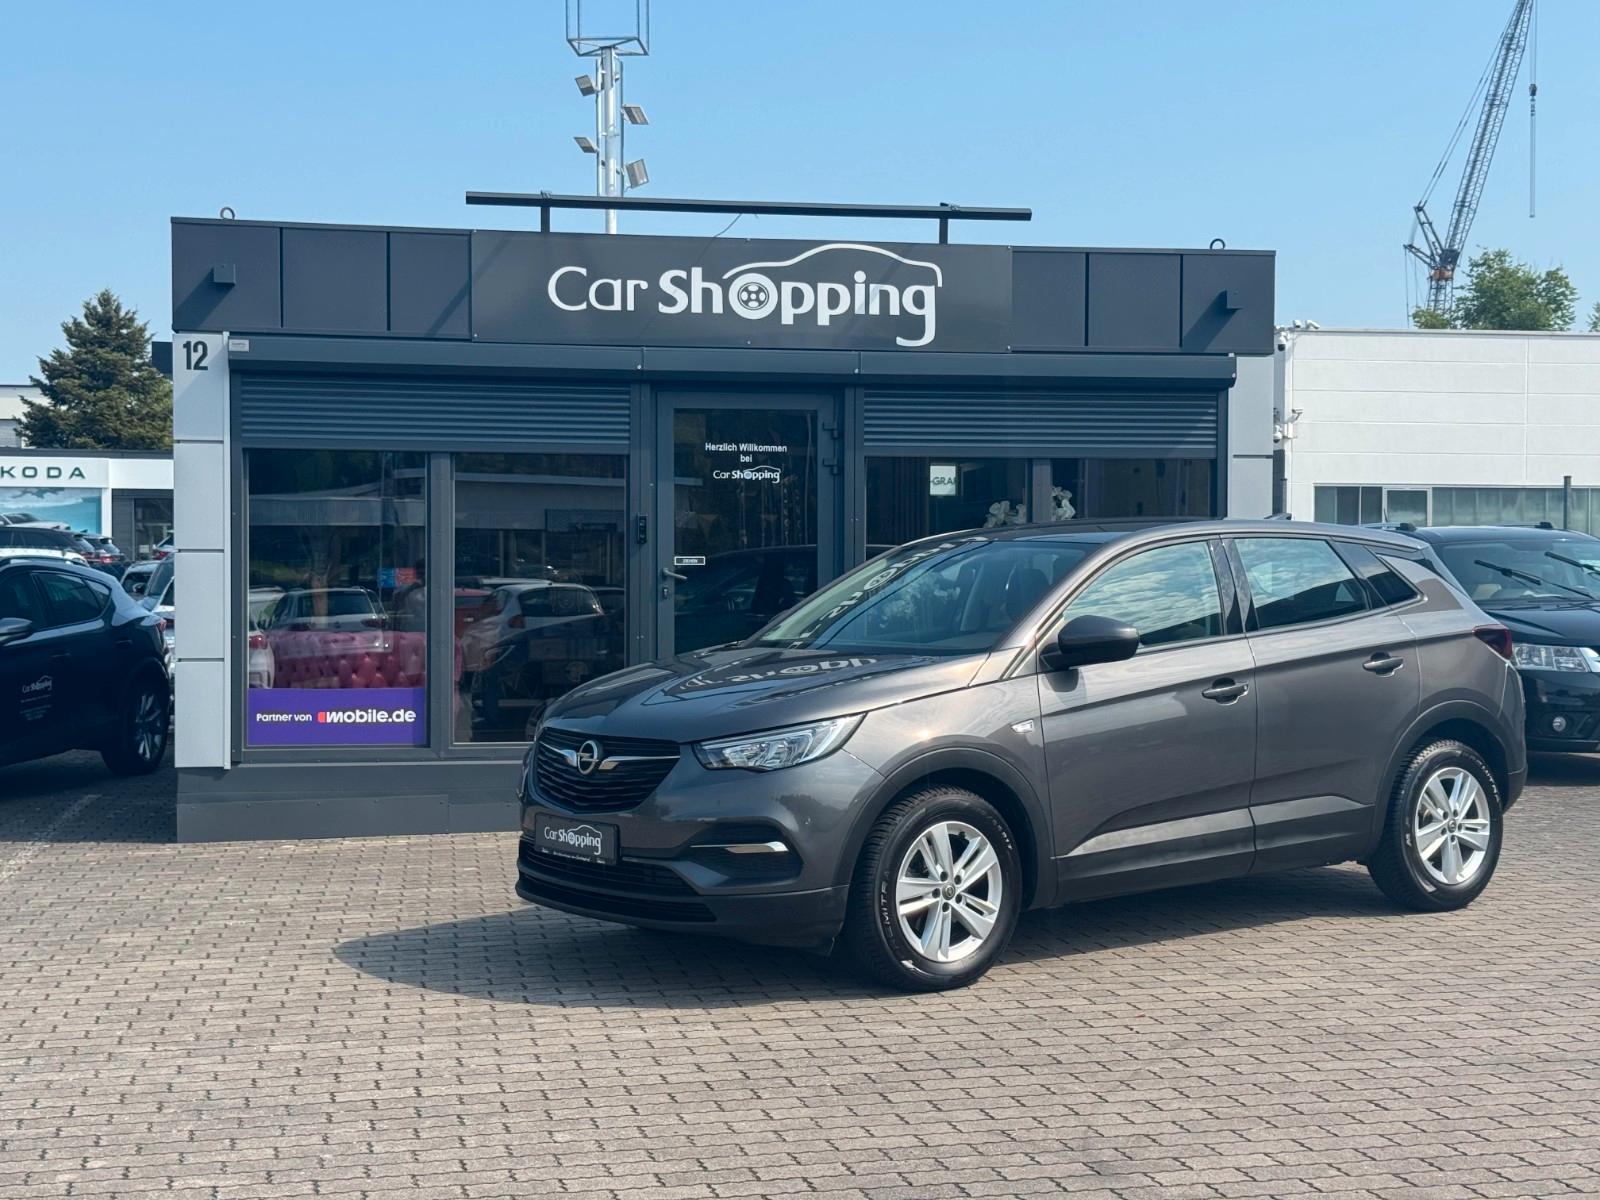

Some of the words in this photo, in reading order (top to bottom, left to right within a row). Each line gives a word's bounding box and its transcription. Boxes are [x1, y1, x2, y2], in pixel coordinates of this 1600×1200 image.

[547, 265, 648, 311] Car
[658, 266, 937, 347] Shopping
[183, 341, 208, 370] 12
[705, 442, 737, 452] Herzlich
[739, 443, 787, 452] Willkommen
[740, 454, 753, 462] bei
[713, 470, 730, 479] Car
[731, 467, 780, 484] Shopping
[256, 713, 292, 722] Partner
[293, 714, 312, 722] von
[325, 709, 417, 723] mobile.de
[544, 826, 558, 841] Car
[558, 828, 602, 855] Shopping
